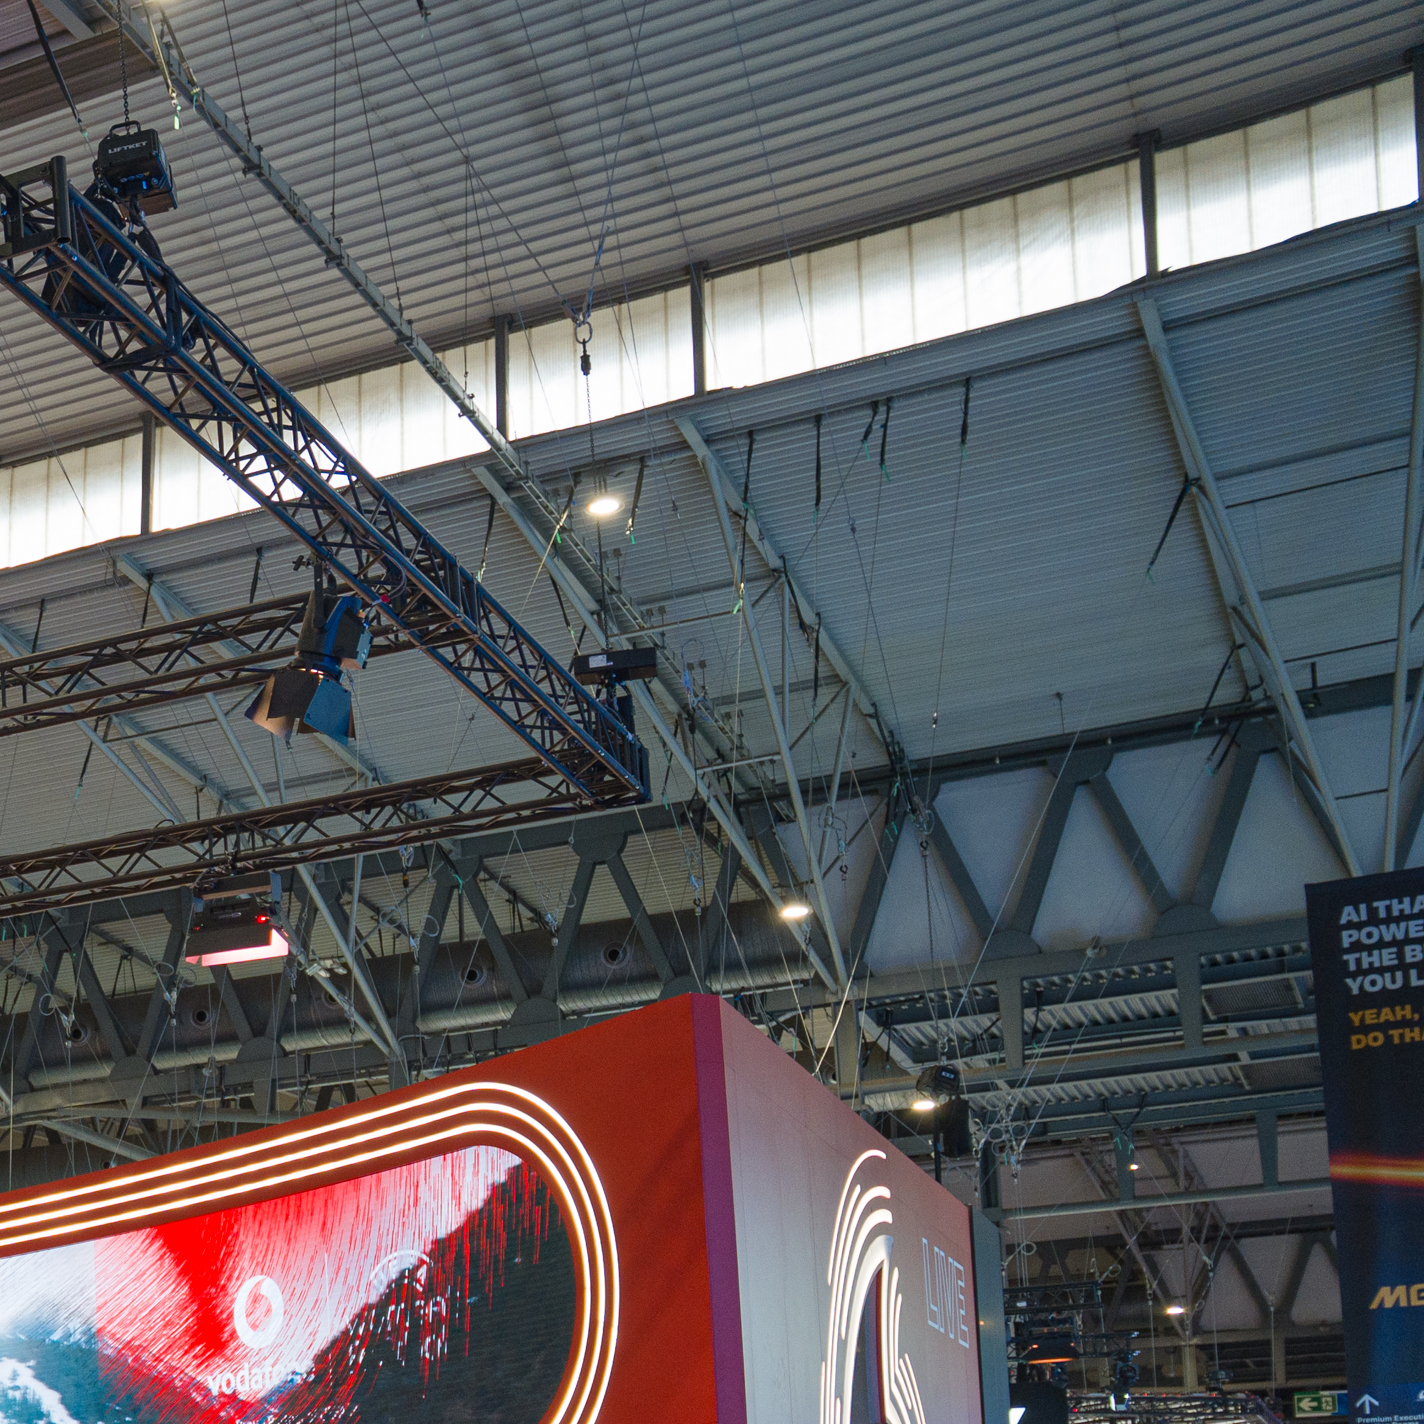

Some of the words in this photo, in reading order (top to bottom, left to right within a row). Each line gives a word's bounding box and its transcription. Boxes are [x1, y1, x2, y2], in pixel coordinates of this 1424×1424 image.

[108, 140, 148, 154] LIFTKET
[1339, 903, 1368, 925] AI
[1340, 919, 1424, 948] POWE
[1342, 947, 1399, 972] THE
[1405, 944, 1424, 964] B
[1344, 970, 1404, 995] YOU
[1348, 1004, 1419, 1027] YEAH,
[1350, 1031, 1385, 1050] DO
[1388, 1028, 1424, 1045] TH
